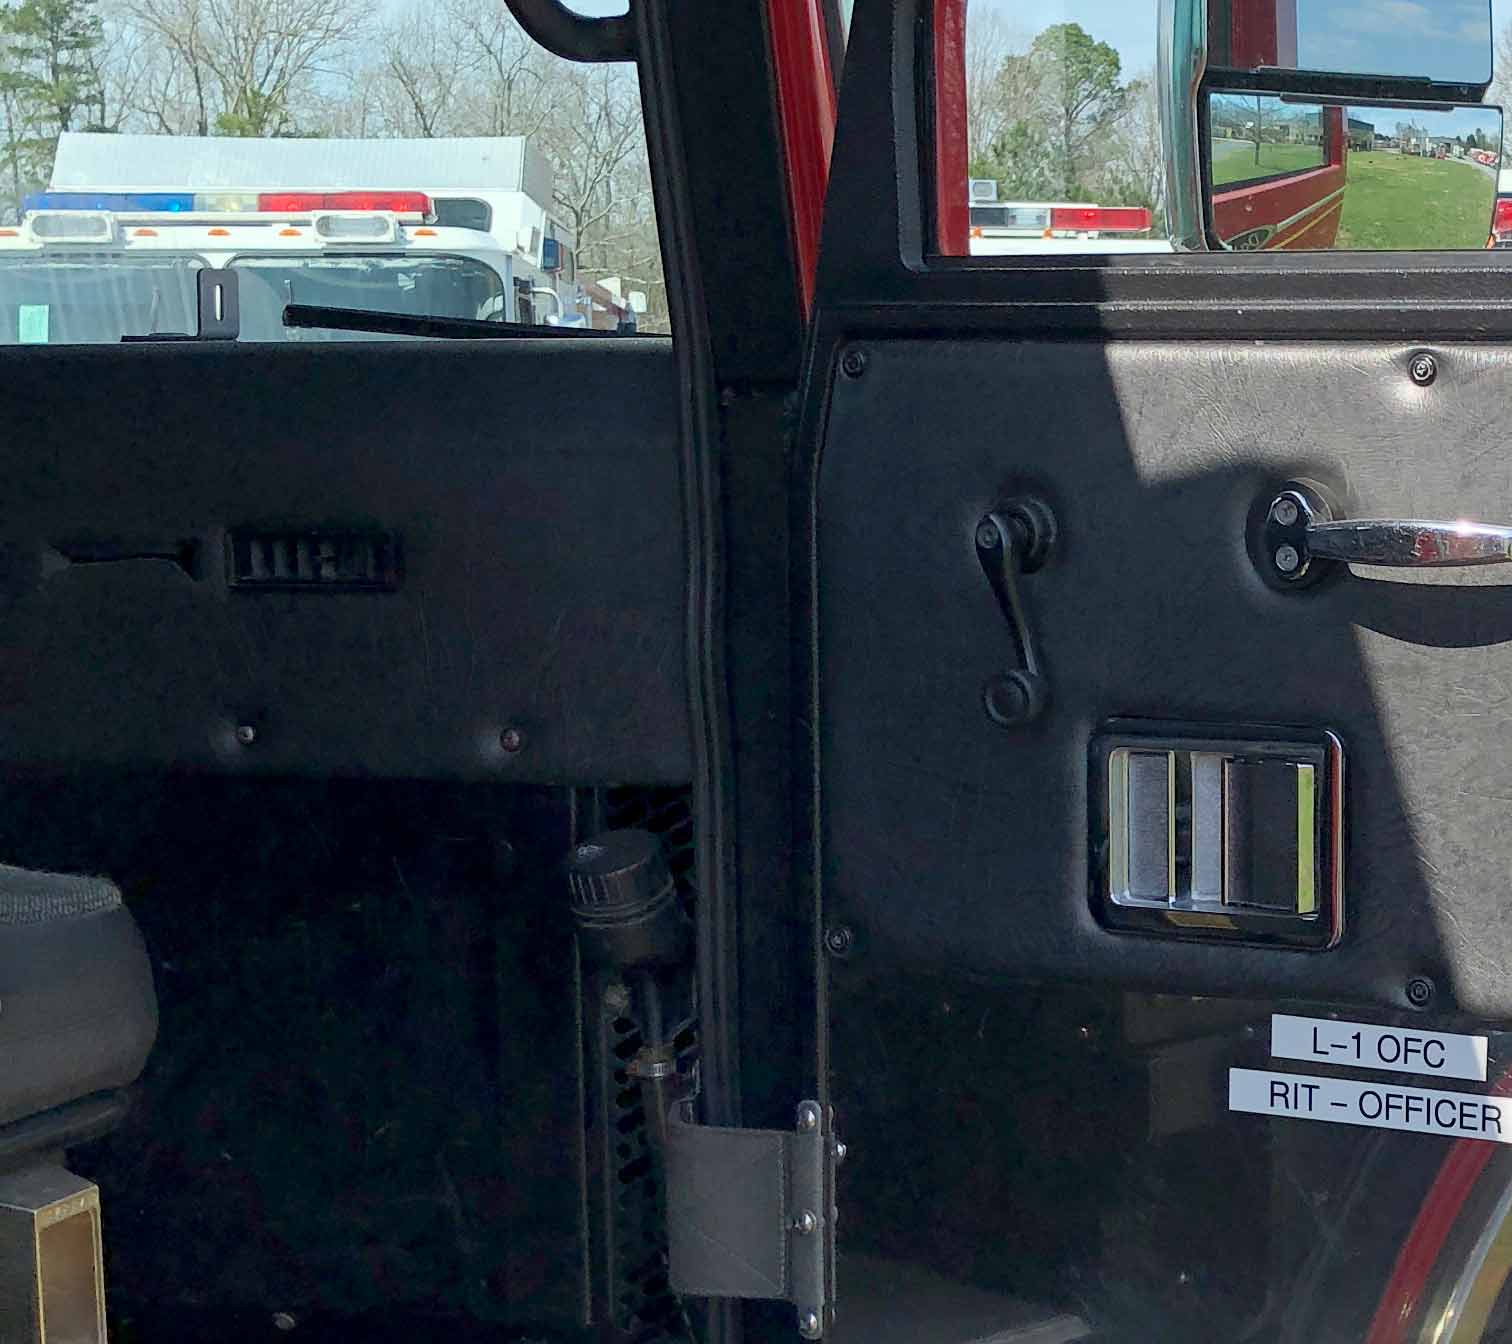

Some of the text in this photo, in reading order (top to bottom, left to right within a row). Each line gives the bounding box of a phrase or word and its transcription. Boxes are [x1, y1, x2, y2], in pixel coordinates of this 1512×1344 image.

[1312, 1026, 1446, 1069] L-1 OFC
[1269, 1080, 1320, 1112] RIT
[1358, 1089, 1502, 1134] OFFICER
